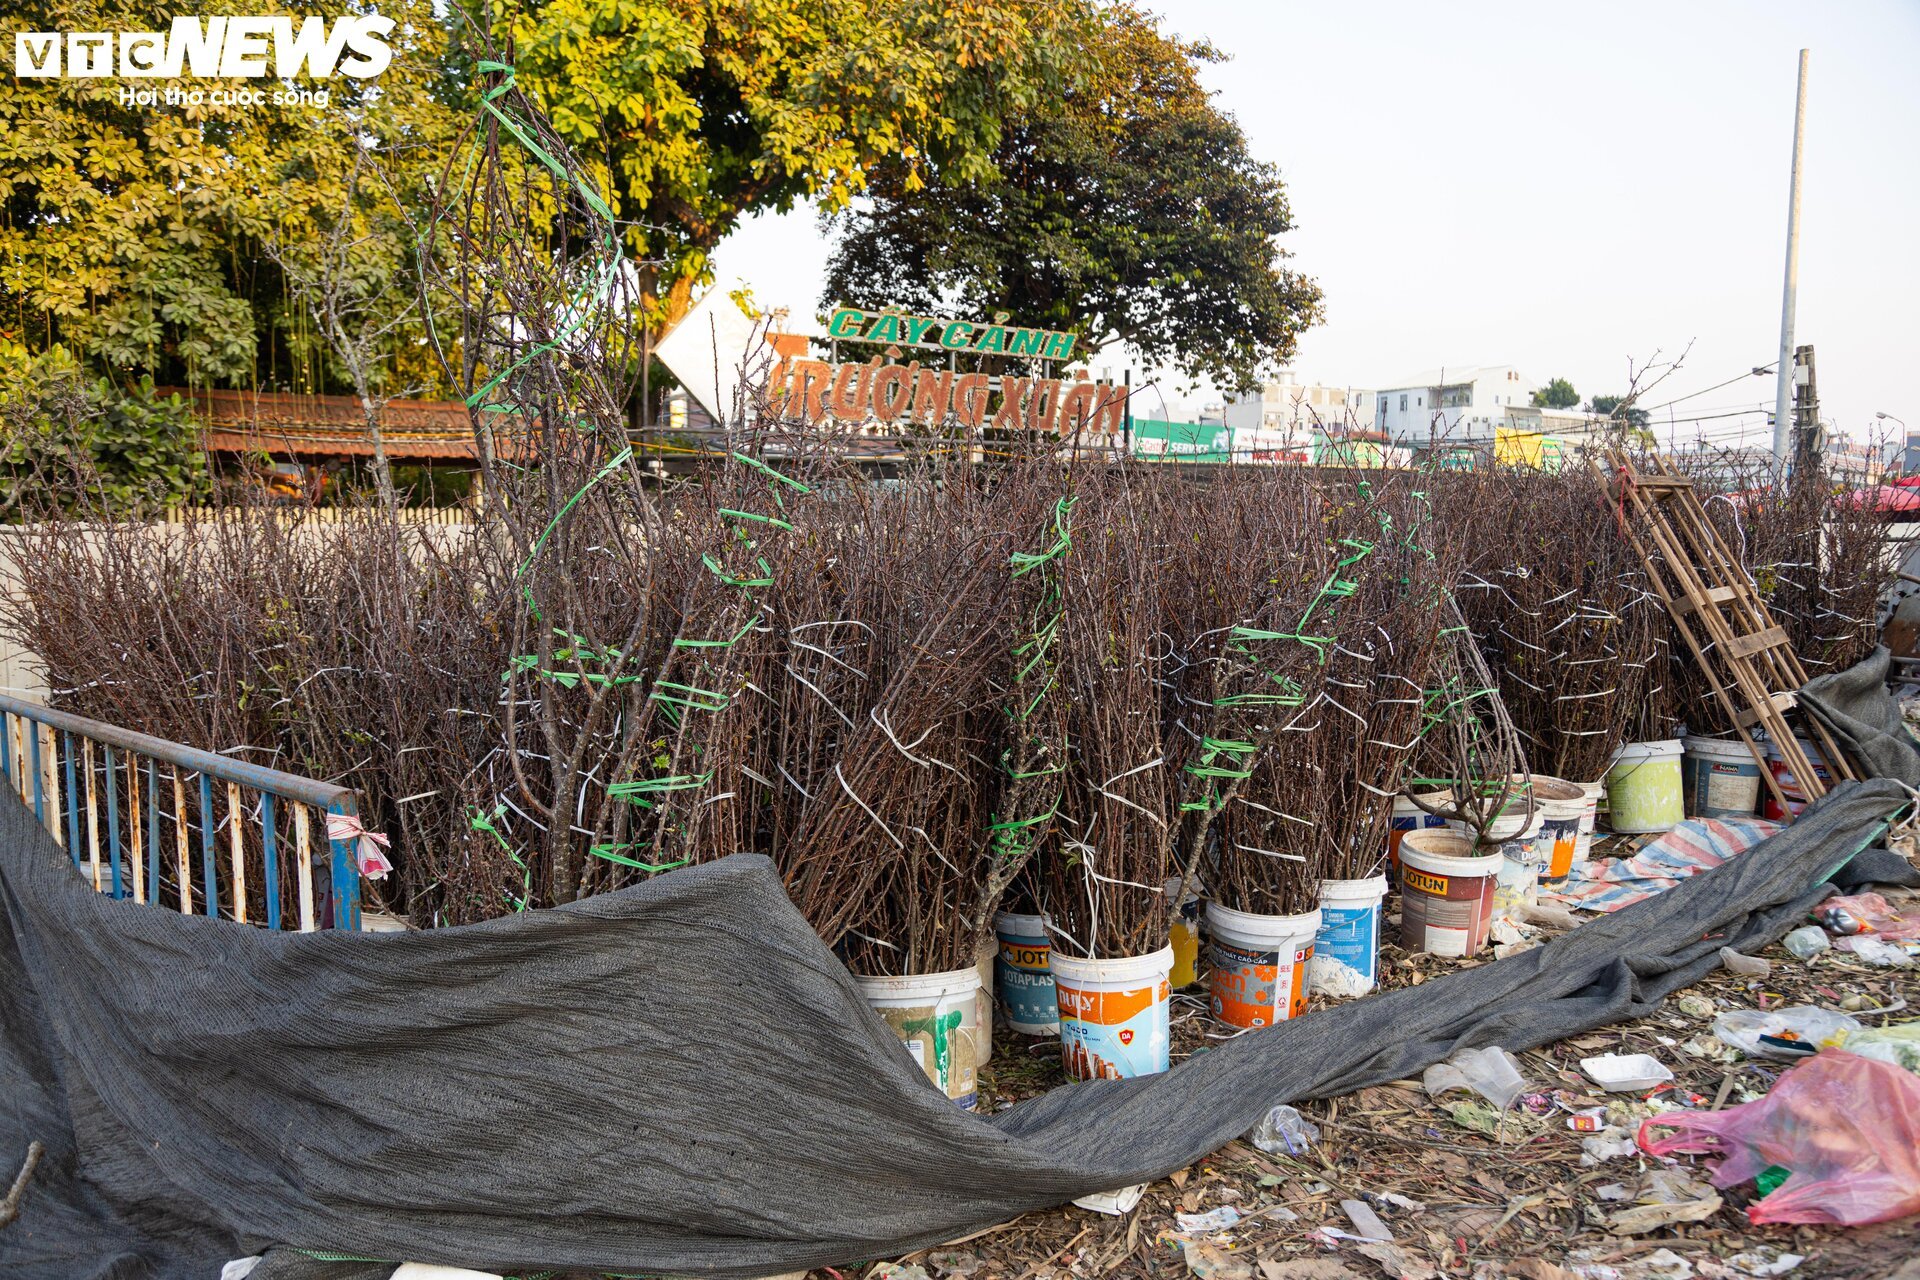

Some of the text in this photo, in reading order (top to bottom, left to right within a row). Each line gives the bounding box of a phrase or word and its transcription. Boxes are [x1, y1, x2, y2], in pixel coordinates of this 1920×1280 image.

[827, 305, 1078, 361] CÂY CẢNH
[992, 368, 1130, 435] XUÂN
[1405, 869, 1444, 891] JOTUN
[1121, 1032, 1131, 1040] DA
